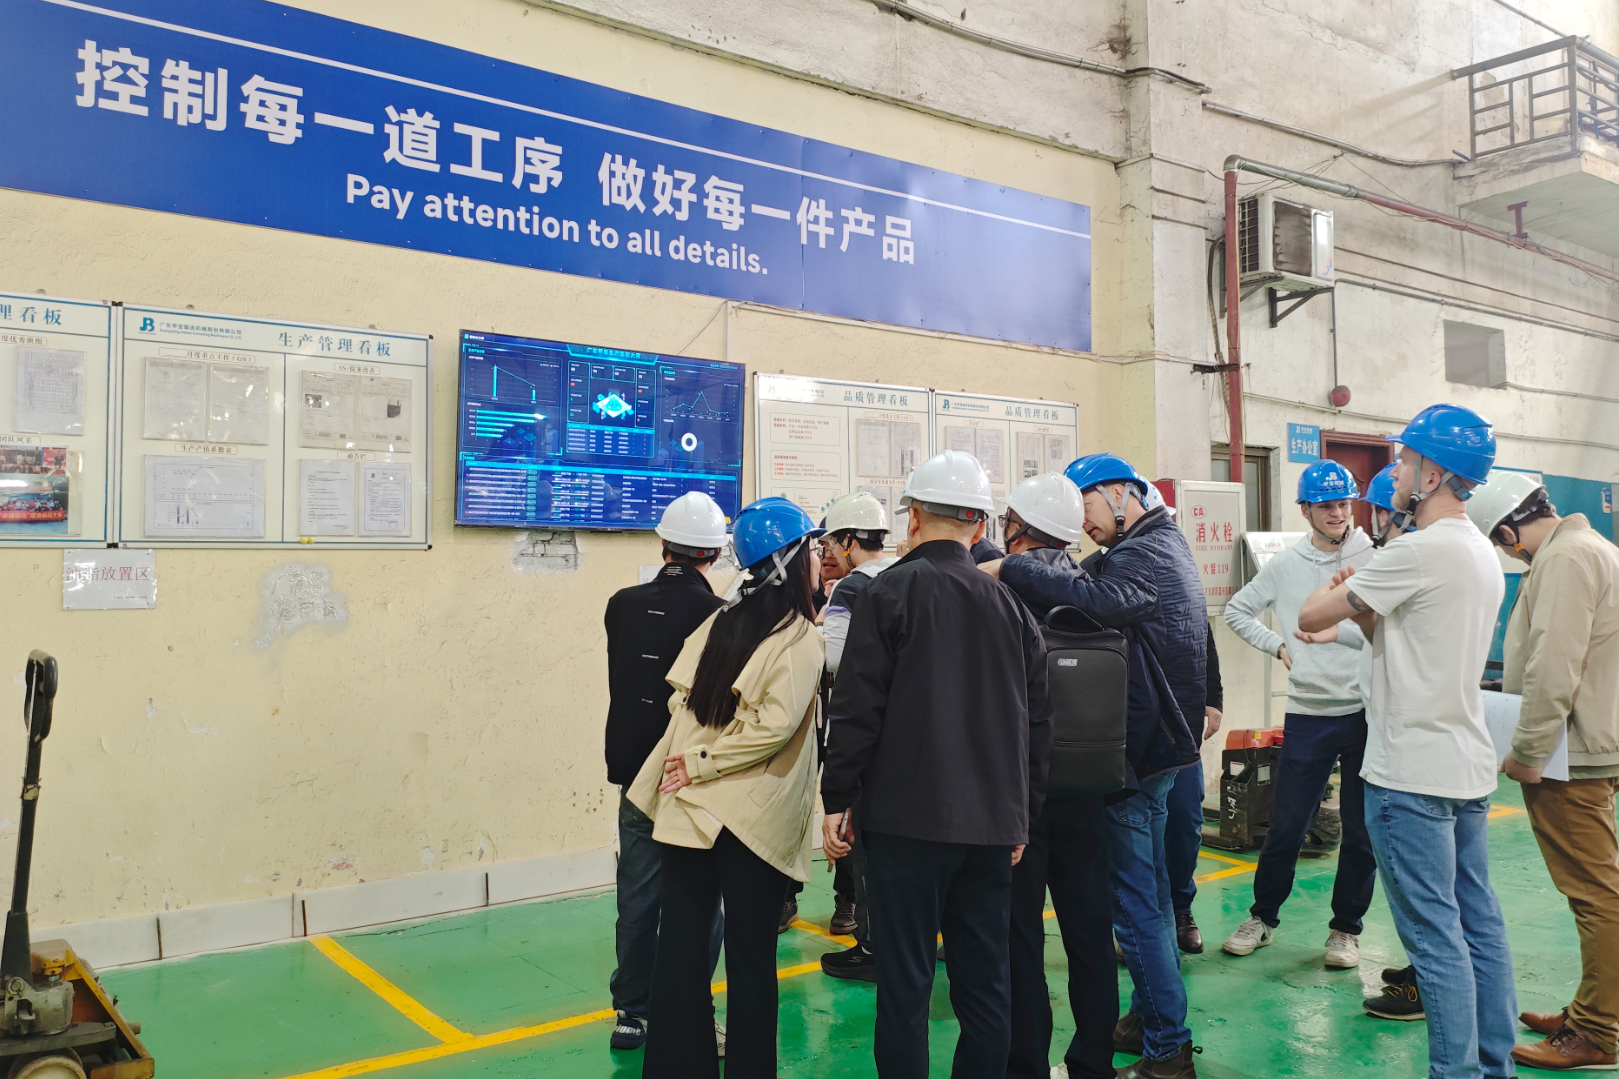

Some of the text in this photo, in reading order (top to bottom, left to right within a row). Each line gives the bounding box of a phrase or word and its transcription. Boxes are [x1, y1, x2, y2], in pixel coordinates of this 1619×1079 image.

[75, 40, 916, 266] 控制每一道工序 做好每一件产品
[346, 173, 768, 275] Pay attention to all details.
[278, 331, 391, 357] 生产管理看板
[844, 389, 908, 407] 品质管理看板
[1005, 405, 1059, 421] 品质管理看板
[1291, 437, 1319, 456] 生产办公室
[1193, 507, 1204, 516] CA
[1195, 521, 1233, 543] 消火栓
